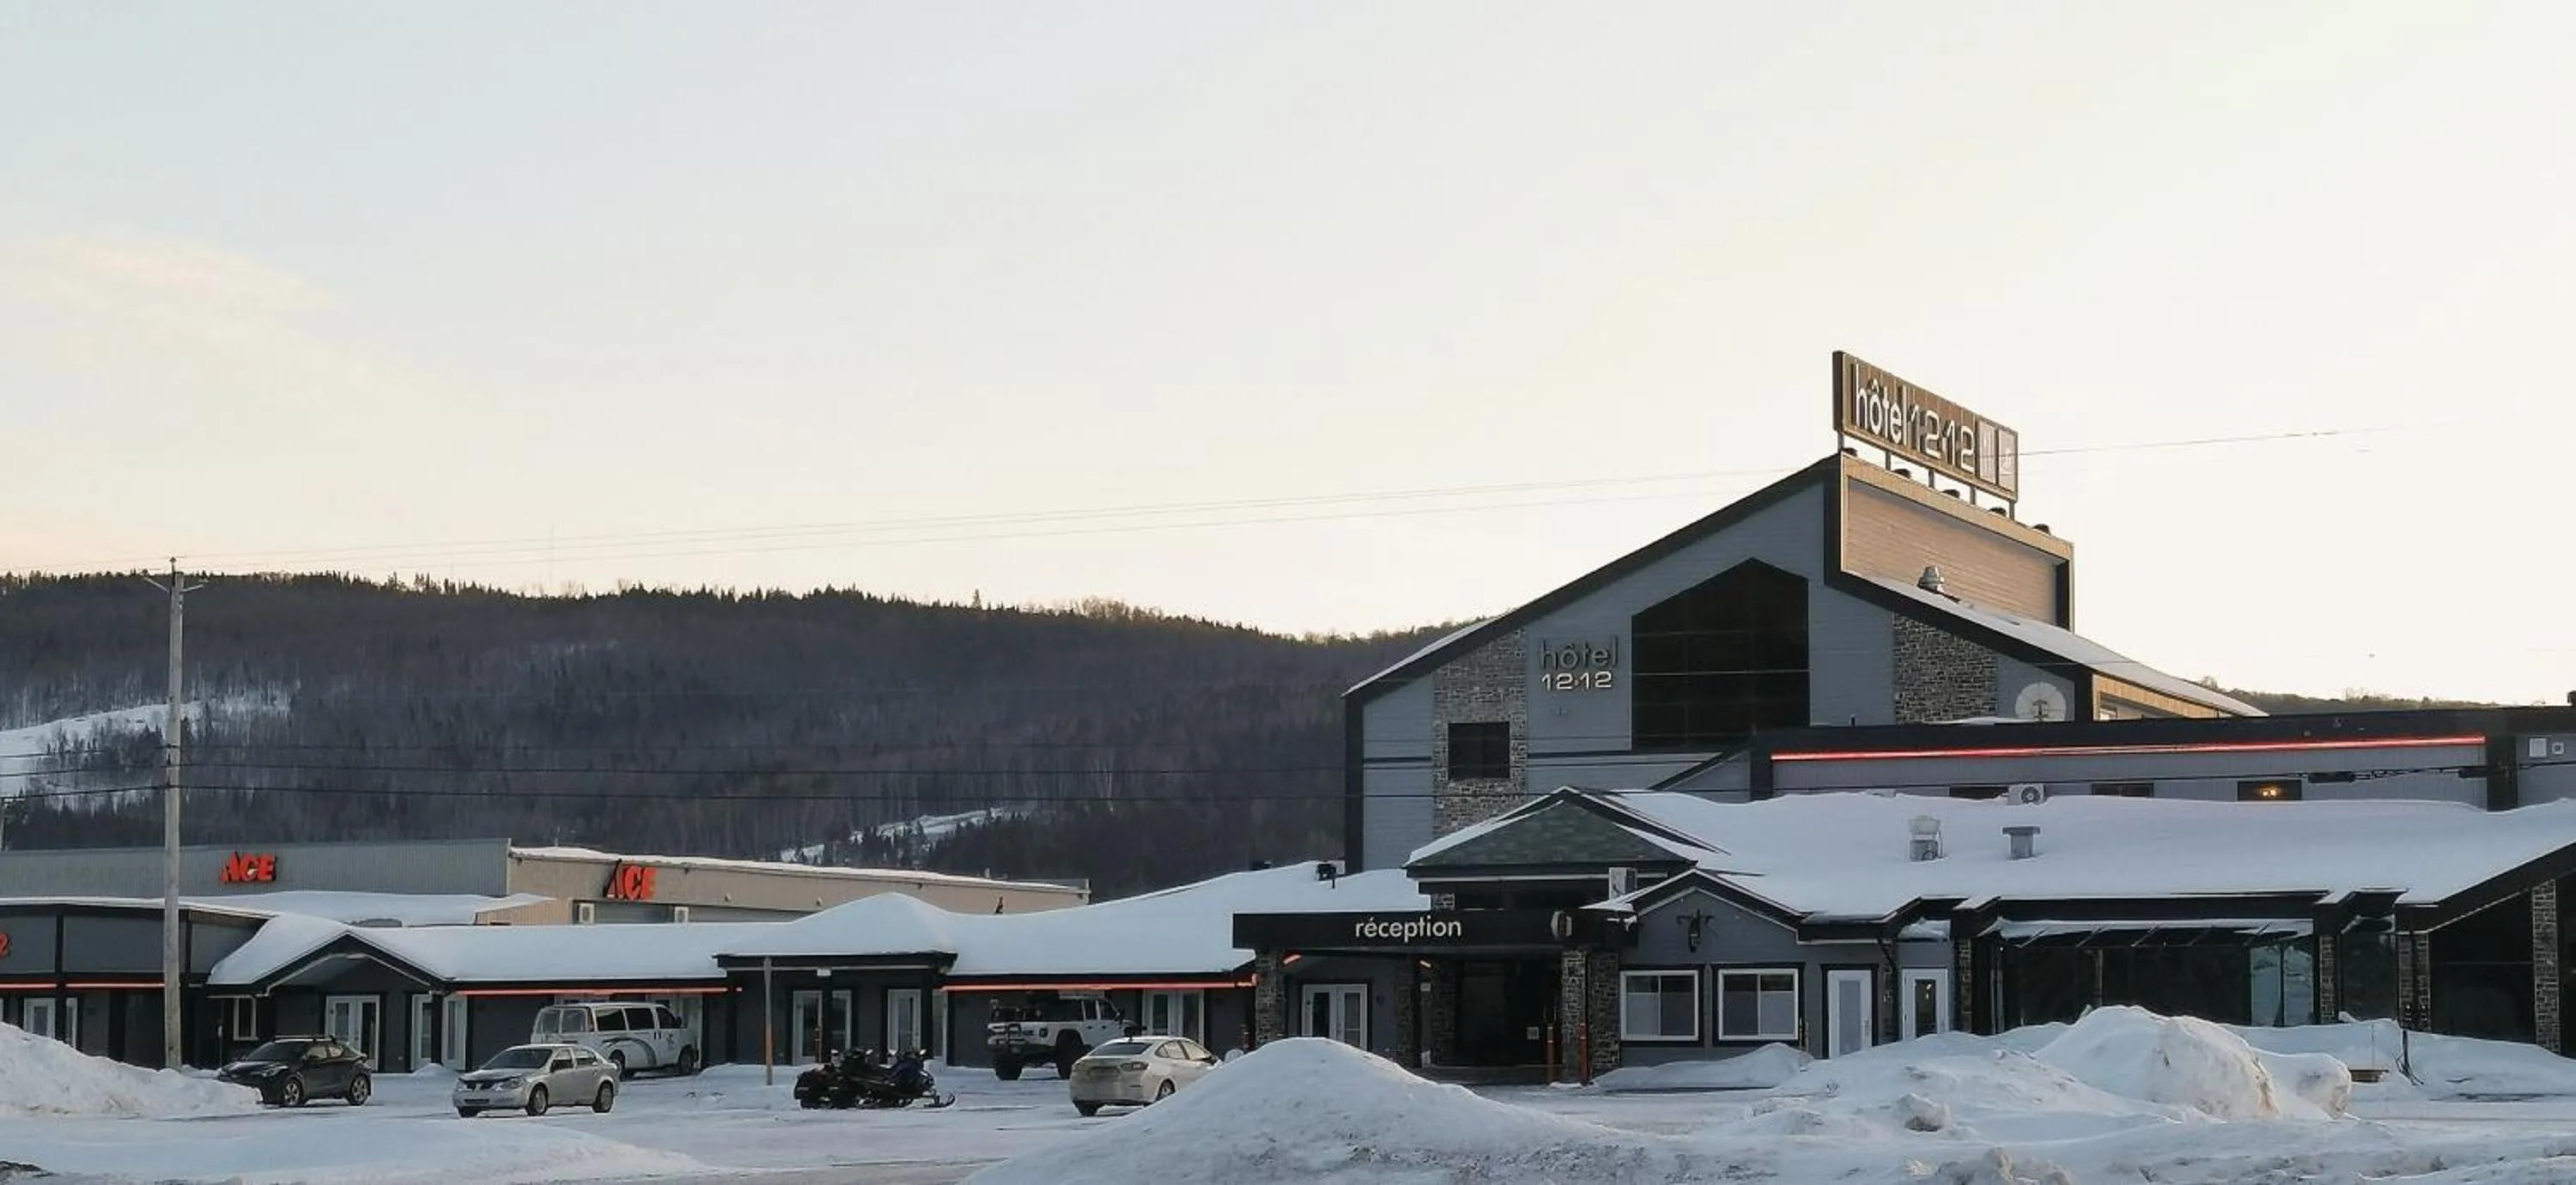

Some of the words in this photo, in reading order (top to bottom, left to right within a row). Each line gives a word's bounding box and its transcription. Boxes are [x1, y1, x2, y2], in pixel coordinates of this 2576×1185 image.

[1856, 363, 1907, 446] hôtel
[1540, 635, 1618, 670] hôtel
[220, 851, 276, 881] ACE
[605, 861, 659, 900] ACE
[1356, 915, 1461, 943] réception
